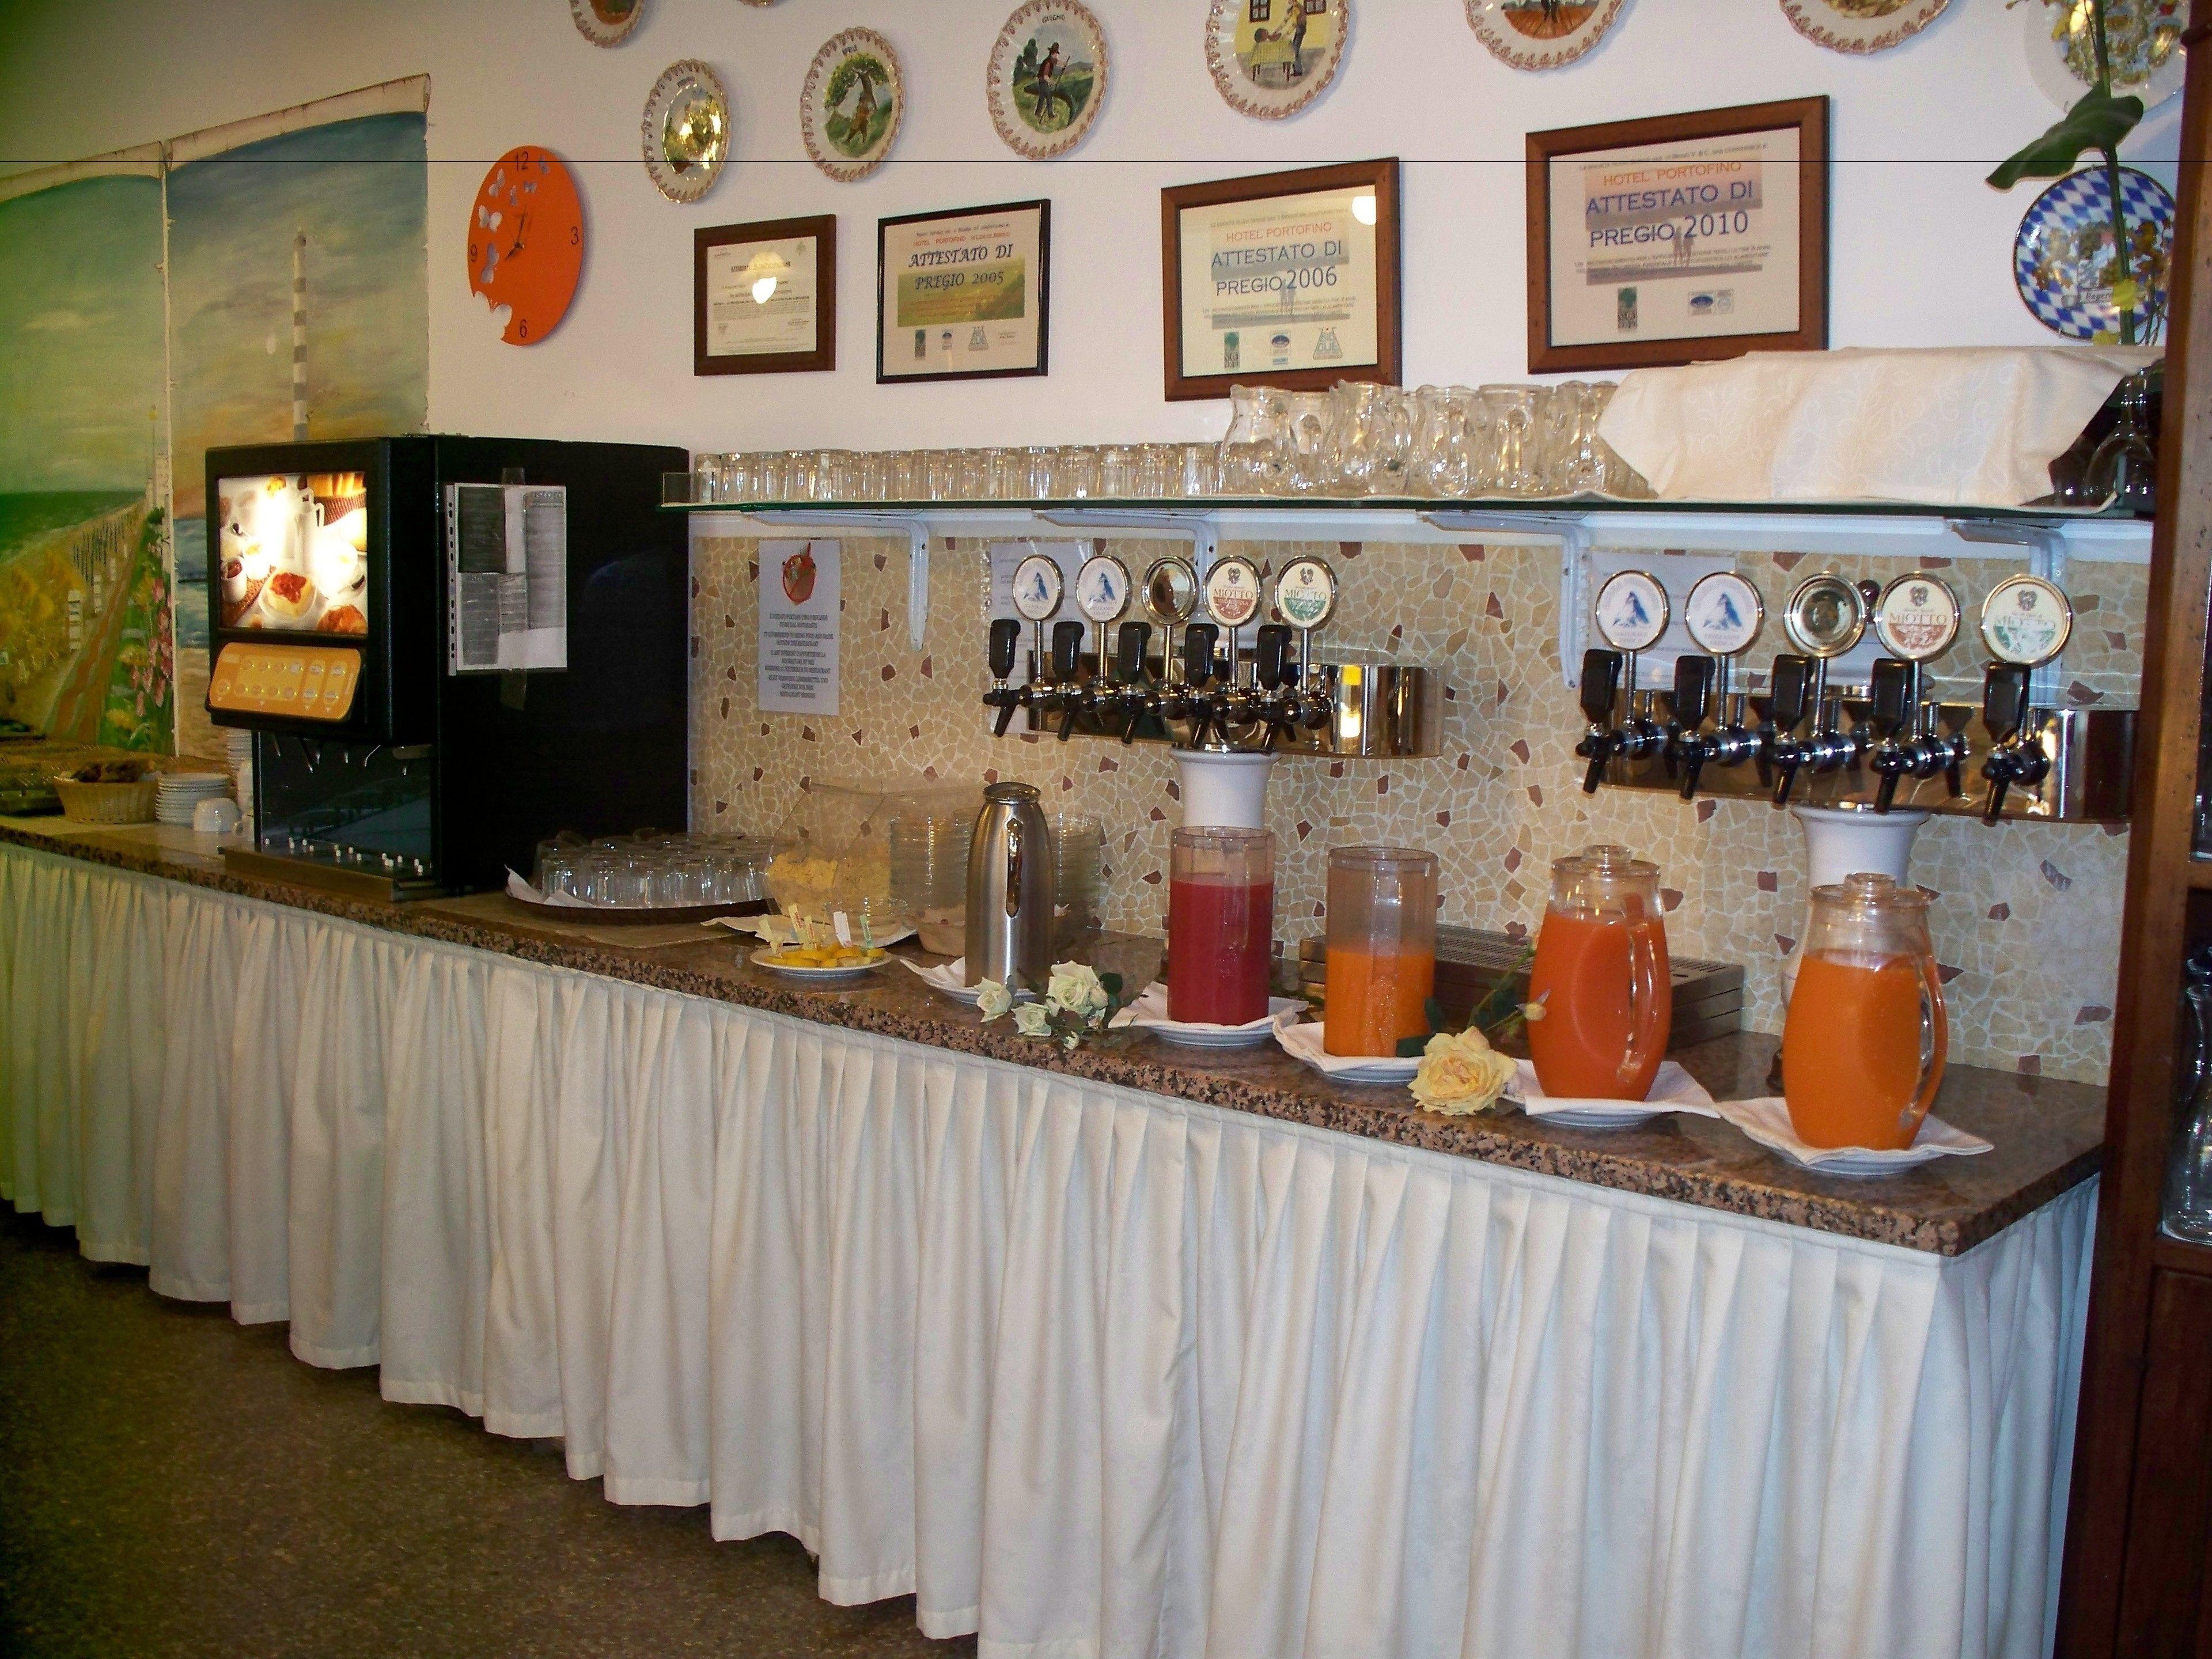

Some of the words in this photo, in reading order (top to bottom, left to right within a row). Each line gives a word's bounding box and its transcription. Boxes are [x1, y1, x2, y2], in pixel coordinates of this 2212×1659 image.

[516, 151, 529, 172] 12
[1603, 172, 1650, 187] HOTEL
[1656, 160, 1742, 180] PORTOFINO
[1586, 184, 1719, 215] ATTESTATO
[1730, 180, 1753, 200] DI
[571, 226, 579, 245] 3
[1226, 230, 1263, 243] HOTEL
[1267, 222, 1332, 238] PORTOFINO
[1590, 223, 1675, 248] PREGIO
[1684, 209, 1748, 238] 2010
[908, 245, 988, 268] ATTESTATO
[995, 243, 1014, 259] DI
[1211, 243, 1315, 268] ATTESTATO
[1324, 240, 1342, 256] DI
[914, 272, 965, 290] PREGIO
[972, 272, 1005, 285] 2005
[1216, 276, 1283, 296] PREGIO
[1286, 266, 1337, 290] 2006
[520, 319, 528, 338] 6
